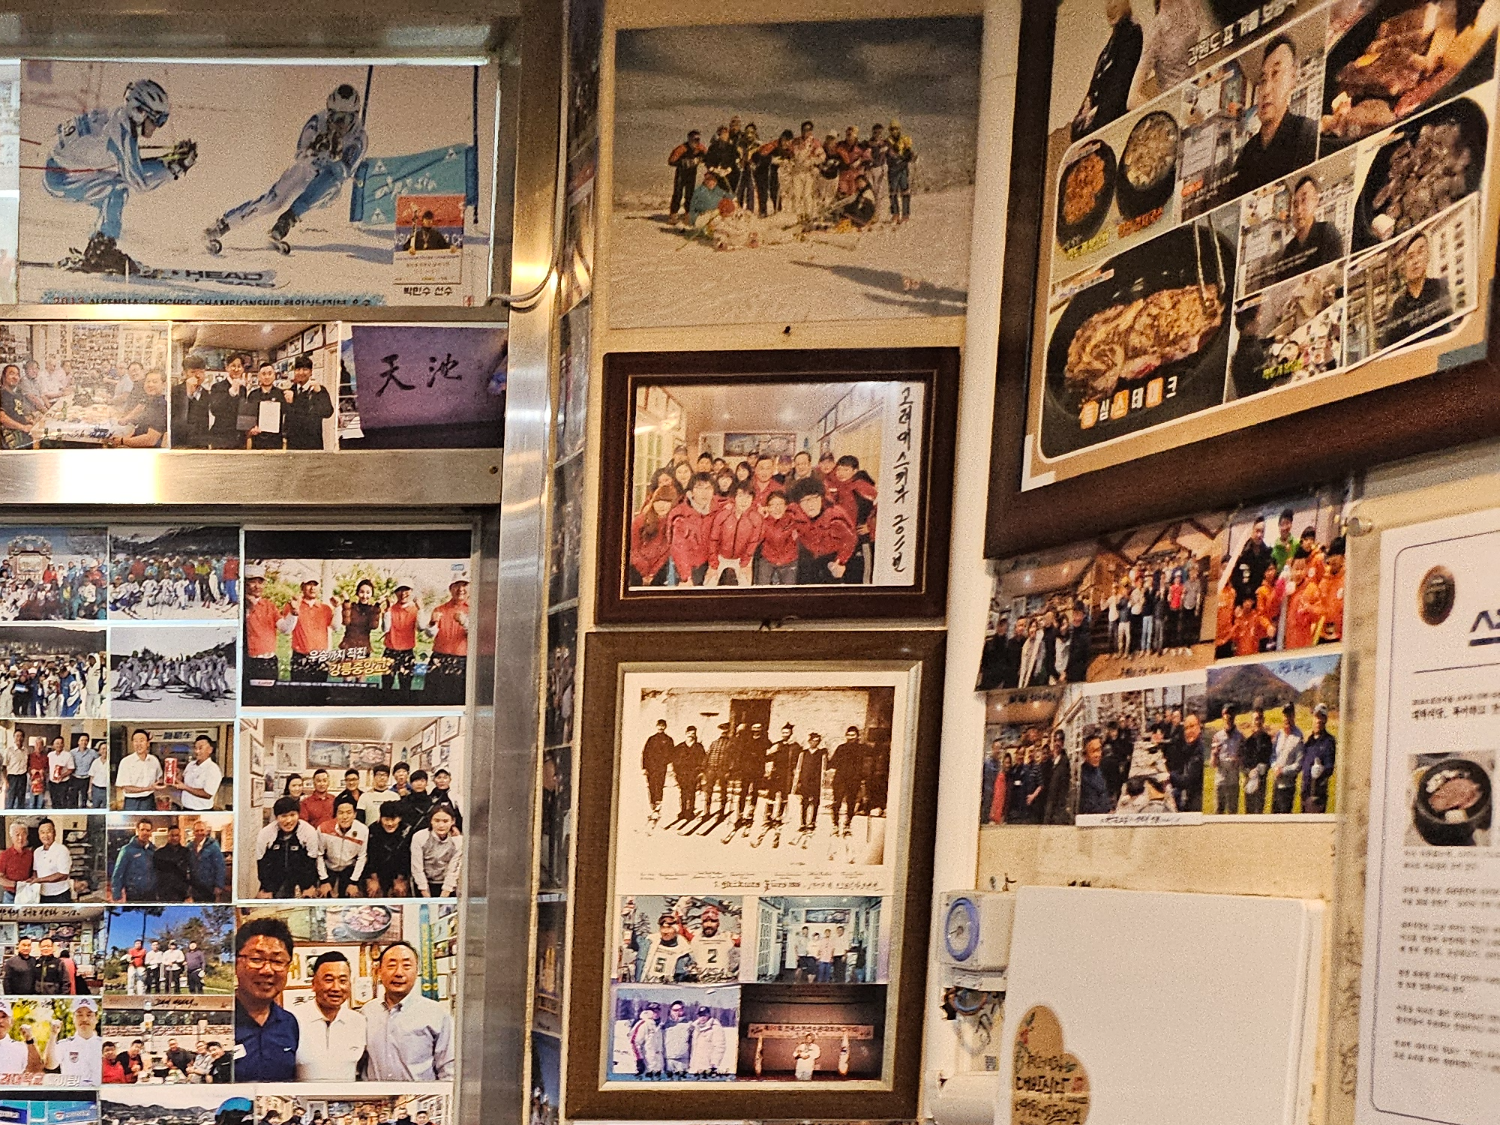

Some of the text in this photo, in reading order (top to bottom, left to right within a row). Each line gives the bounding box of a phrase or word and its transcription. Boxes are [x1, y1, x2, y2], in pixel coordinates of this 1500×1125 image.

[185, 270, 263, 281] HEAD
[375, 353, 463, 397] 天池
[707, 948, 718, 963] 2
[654, 957, 665, 973] 5
